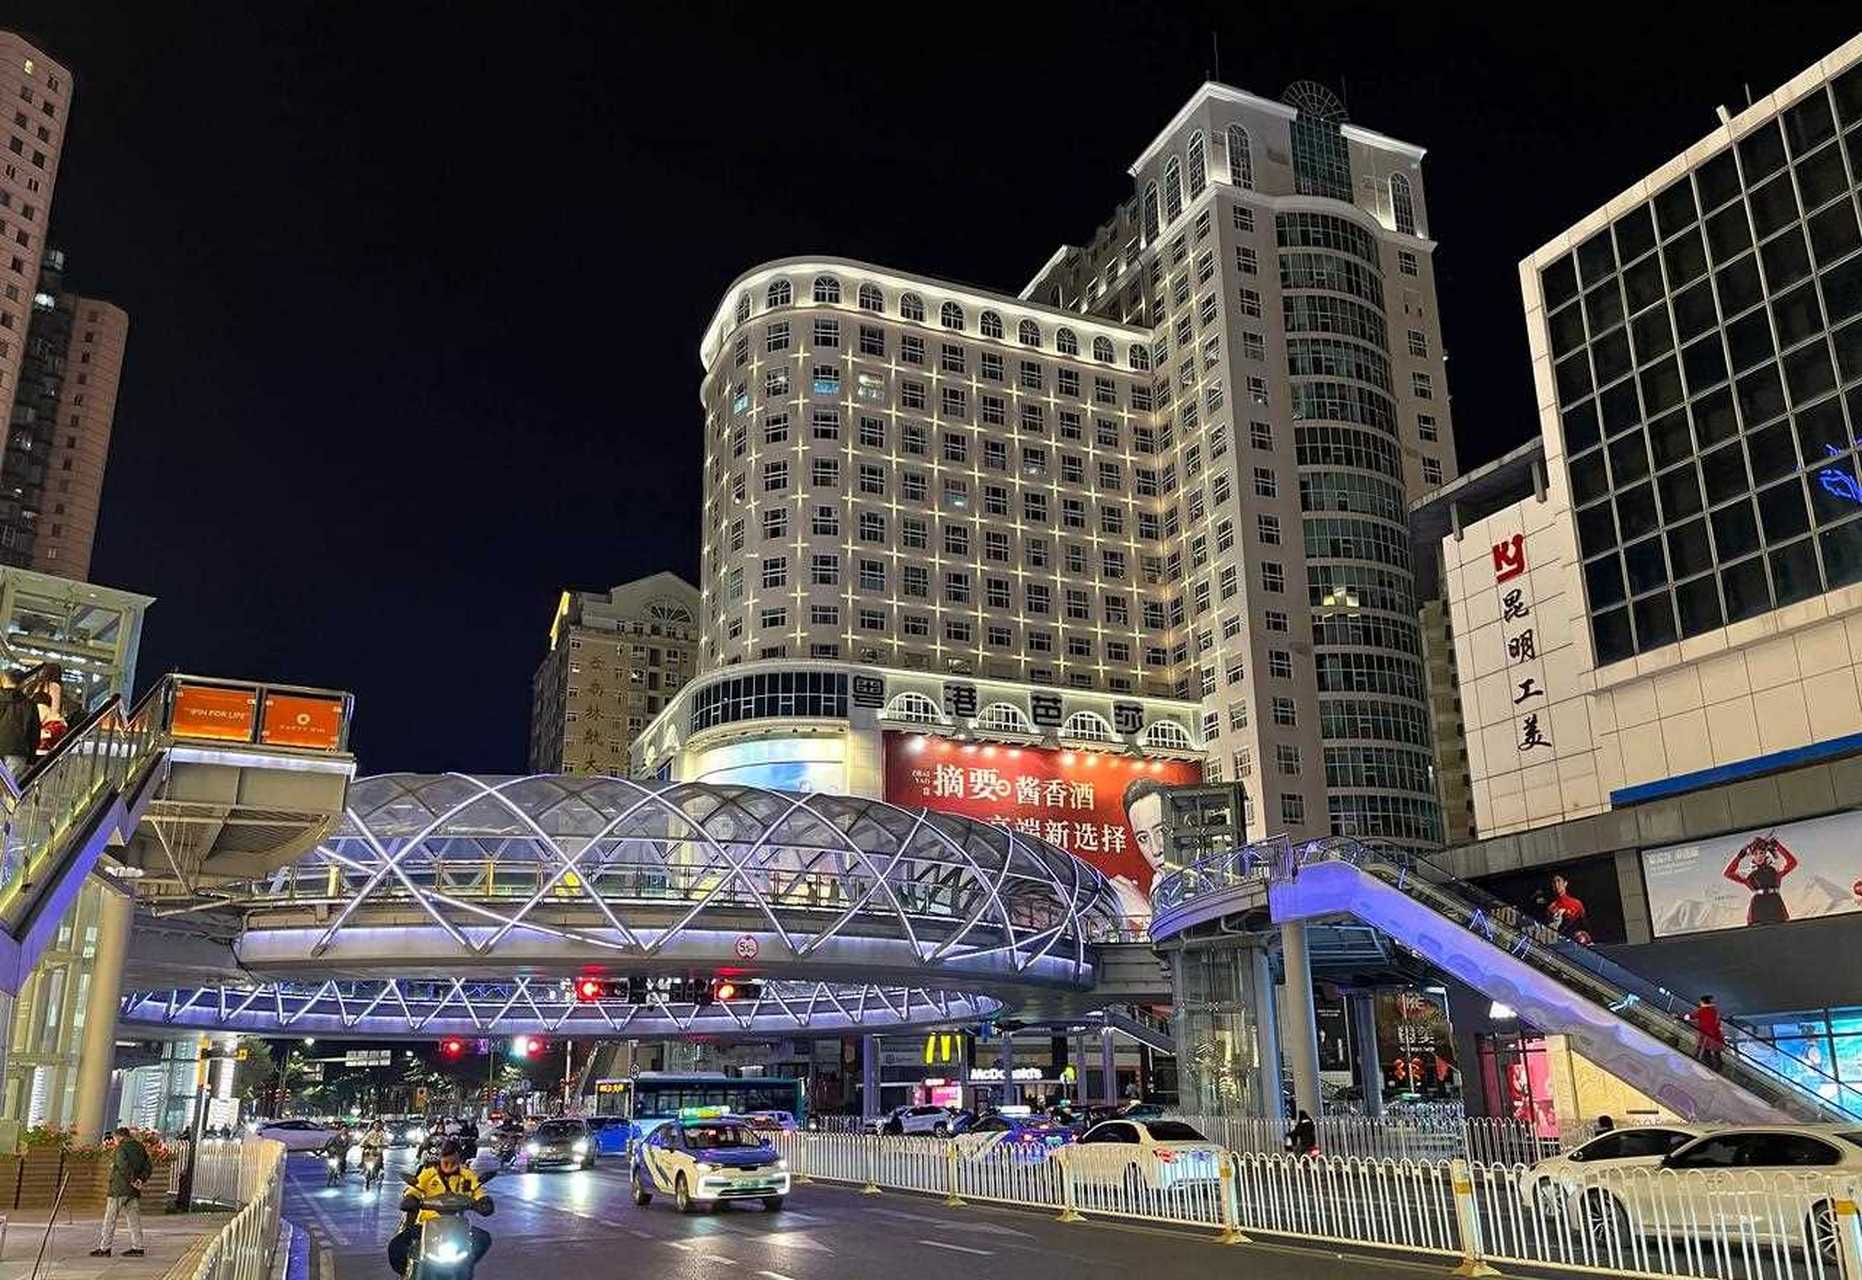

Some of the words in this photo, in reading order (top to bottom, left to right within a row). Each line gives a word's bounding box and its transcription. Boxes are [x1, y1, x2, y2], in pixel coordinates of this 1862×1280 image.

[1503, 588, 1552, 751] 昆明工美
[933, 763, 1000, 802] 摘要
[1014, 775, 1095, 811] 酱香酒
